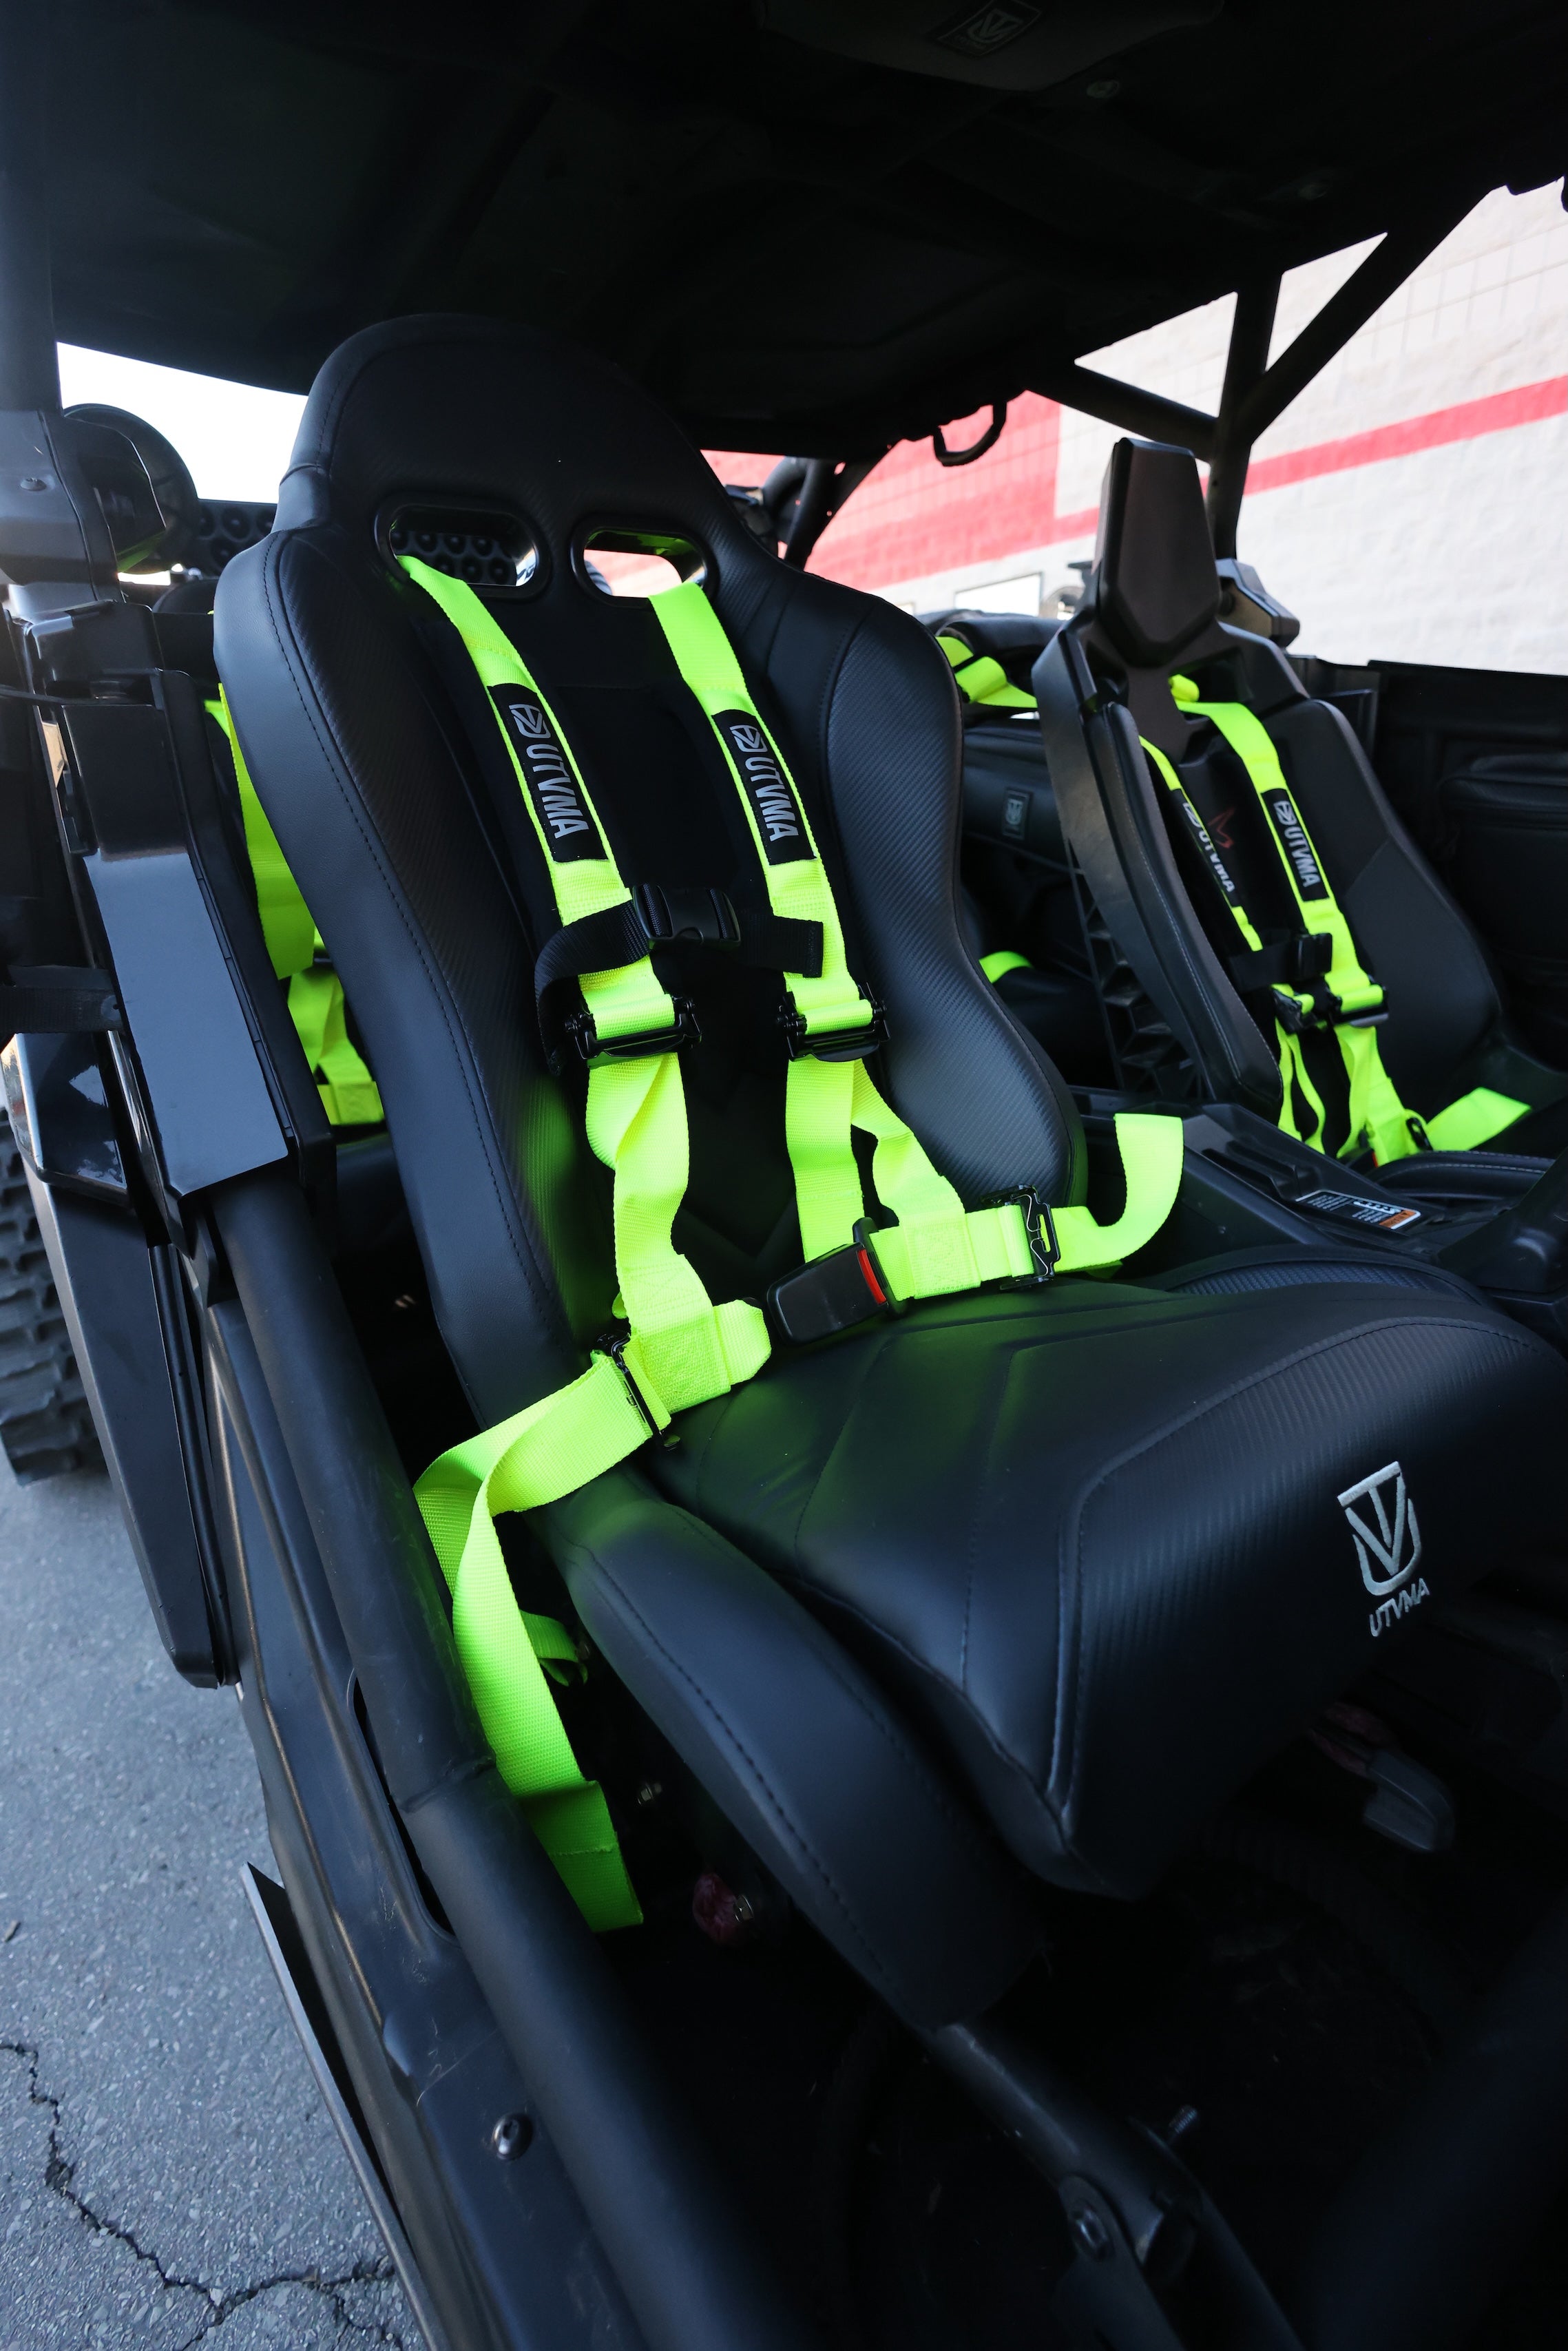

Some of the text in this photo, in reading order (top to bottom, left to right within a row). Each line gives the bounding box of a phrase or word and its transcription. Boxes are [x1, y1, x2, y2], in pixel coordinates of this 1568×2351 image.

[526, 744, 589, 839] UTVMA
[744, 756, 799, 842] UTVMA
[1284, 826, 1321, 888] UTVMA
[1369, 1578, 1430, 1637] UTVMA
